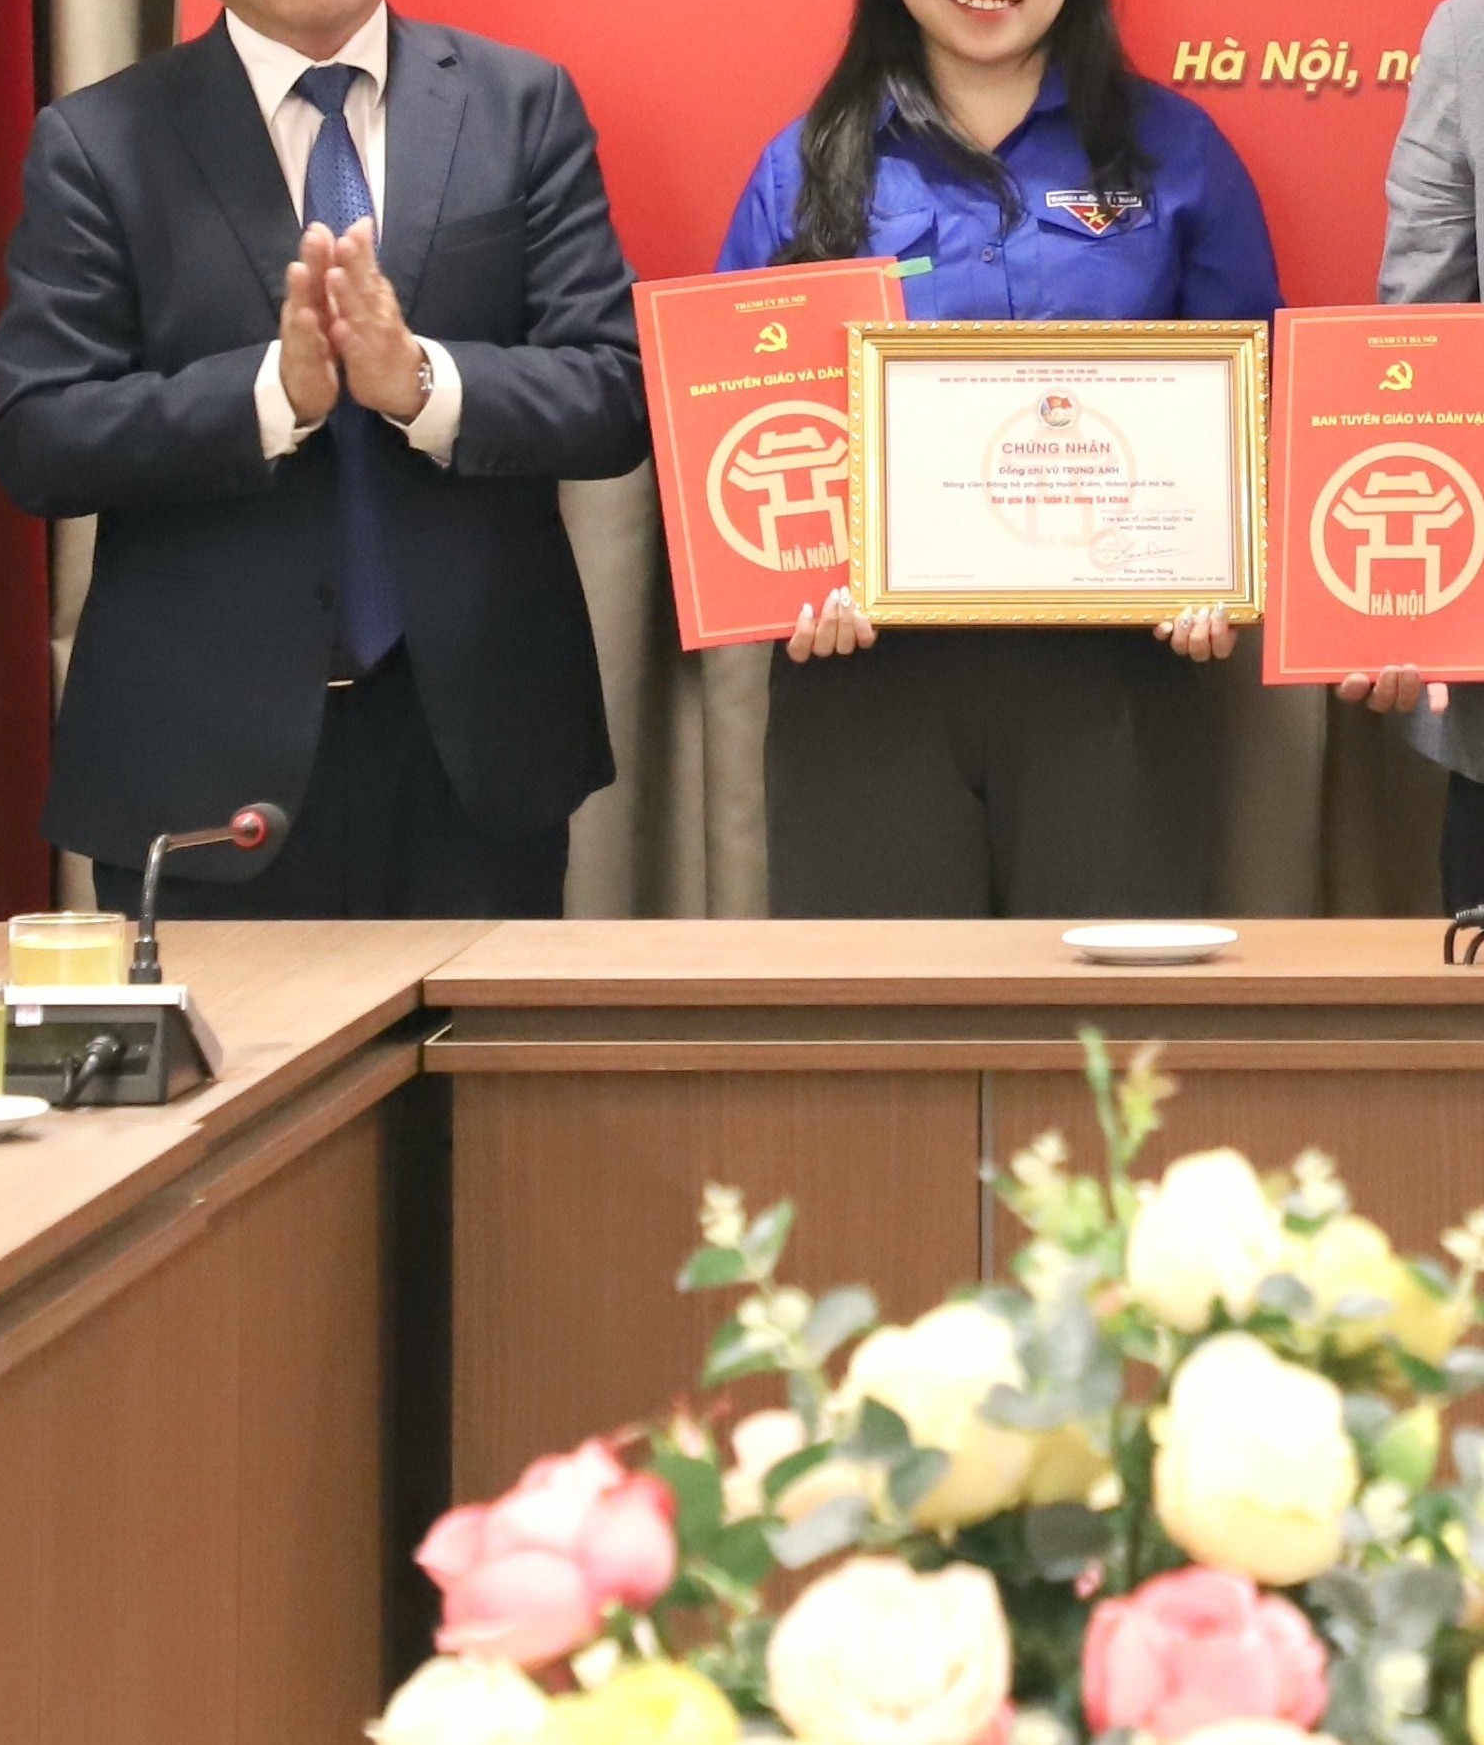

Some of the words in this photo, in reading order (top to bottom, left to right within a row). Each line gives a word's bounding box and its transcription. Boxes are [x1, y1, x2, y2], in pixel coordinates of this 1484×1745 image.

[1174, 40, 1247, 82] Hà
[1263, 40, 1359, 88] Nội,
[689, 383, 717, 397] BAN
[720, 375, 761, 391] TUYÊN
[763, 369, 795, 386] GIÁO
[797, 367, 815, 381] VÀ
[817, 366, 844, 380] DÂN
[1312, 415, 1337, 426] BAN
[1340, 412, 1380, 425] TUYÊN
[1383, 411, 1413, 425] GIÁO
[1416, 412, 1433, 424] VÀ
[1437, 410, 1463, 424] DÂN
[1002, 439, 1060, 454] CHỨNG
[1066, 439, 1110, 456] NHẬN
[781, 544, 806, 571] HÀ
[806, 541, 836, 573] NỘI
[1371, 589, 1394, 616] HÀ
[1396, 588, 1424, 621] NỘI
